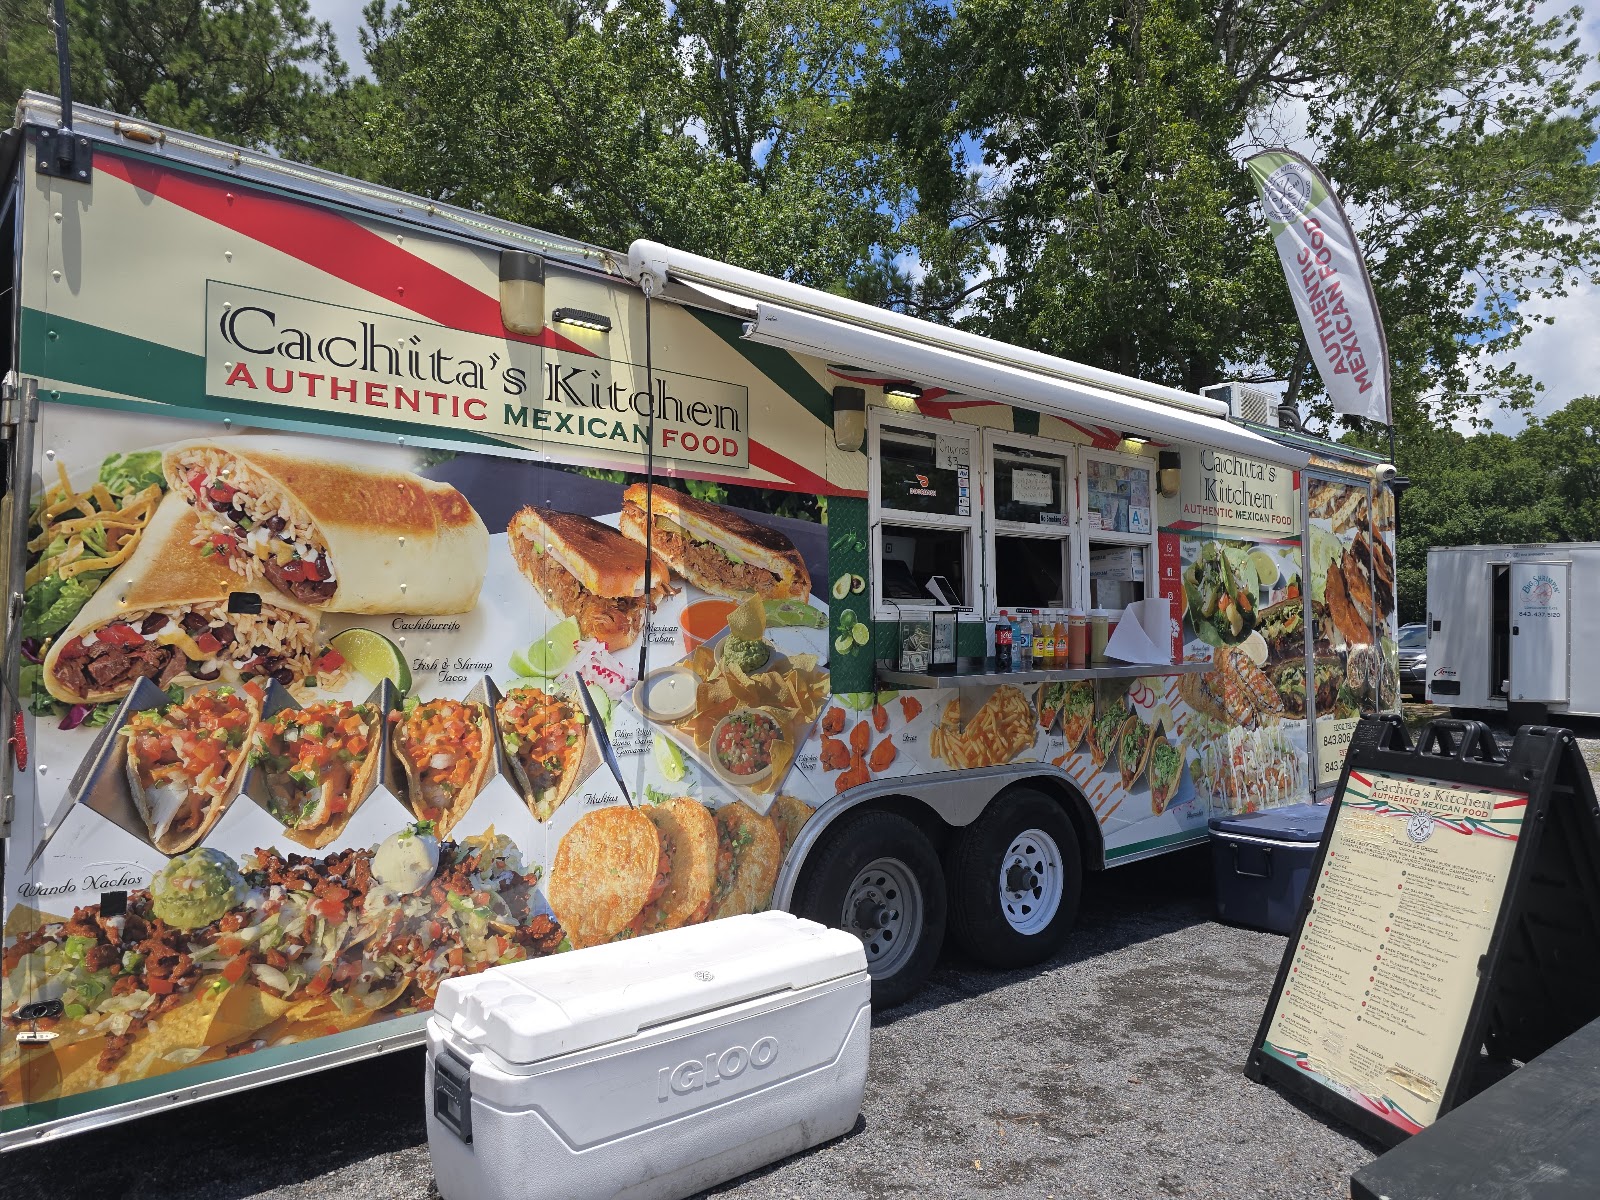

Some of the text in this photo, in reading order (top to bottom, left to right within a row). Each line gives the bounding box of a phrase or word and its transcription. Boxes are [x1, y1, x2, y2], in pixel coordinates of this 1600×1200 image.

[1297, 247, 1350, 375] AUTHENTIC
[1304, 217, 1373, 394] MEXICAN FOOD
[220, 306, 741, 433] Cachita's Kitchen
[225, 362, 739, 457] AUTHENTIC MEXICAN FOOD
[1200, 449, 1277, 482] Cachita's
[1204, 477, 1274, 509] Kitchen
[1132, 511, 1140, 524] A
[1183, 504, 1292, 525] AUTHENTIC MEXICAN FOOD
[392, 617, 461, 633] Cachiburrito
[647, 633, 673, 643] Cuban
[413, 658, 438, 671] Fish
[453, 656, 493, 673] Shrimp
[438, 671, 468, 683] Tacos
[1371, 791, 1489, 818] AUTHENTIC MEXICAN FOOD
[1373, 779, 1492, 810] Cachita's Kitchen
[18, 871, 143, 898] Wando Nachos
[658, 1036, 779, 1103] IGLOO
